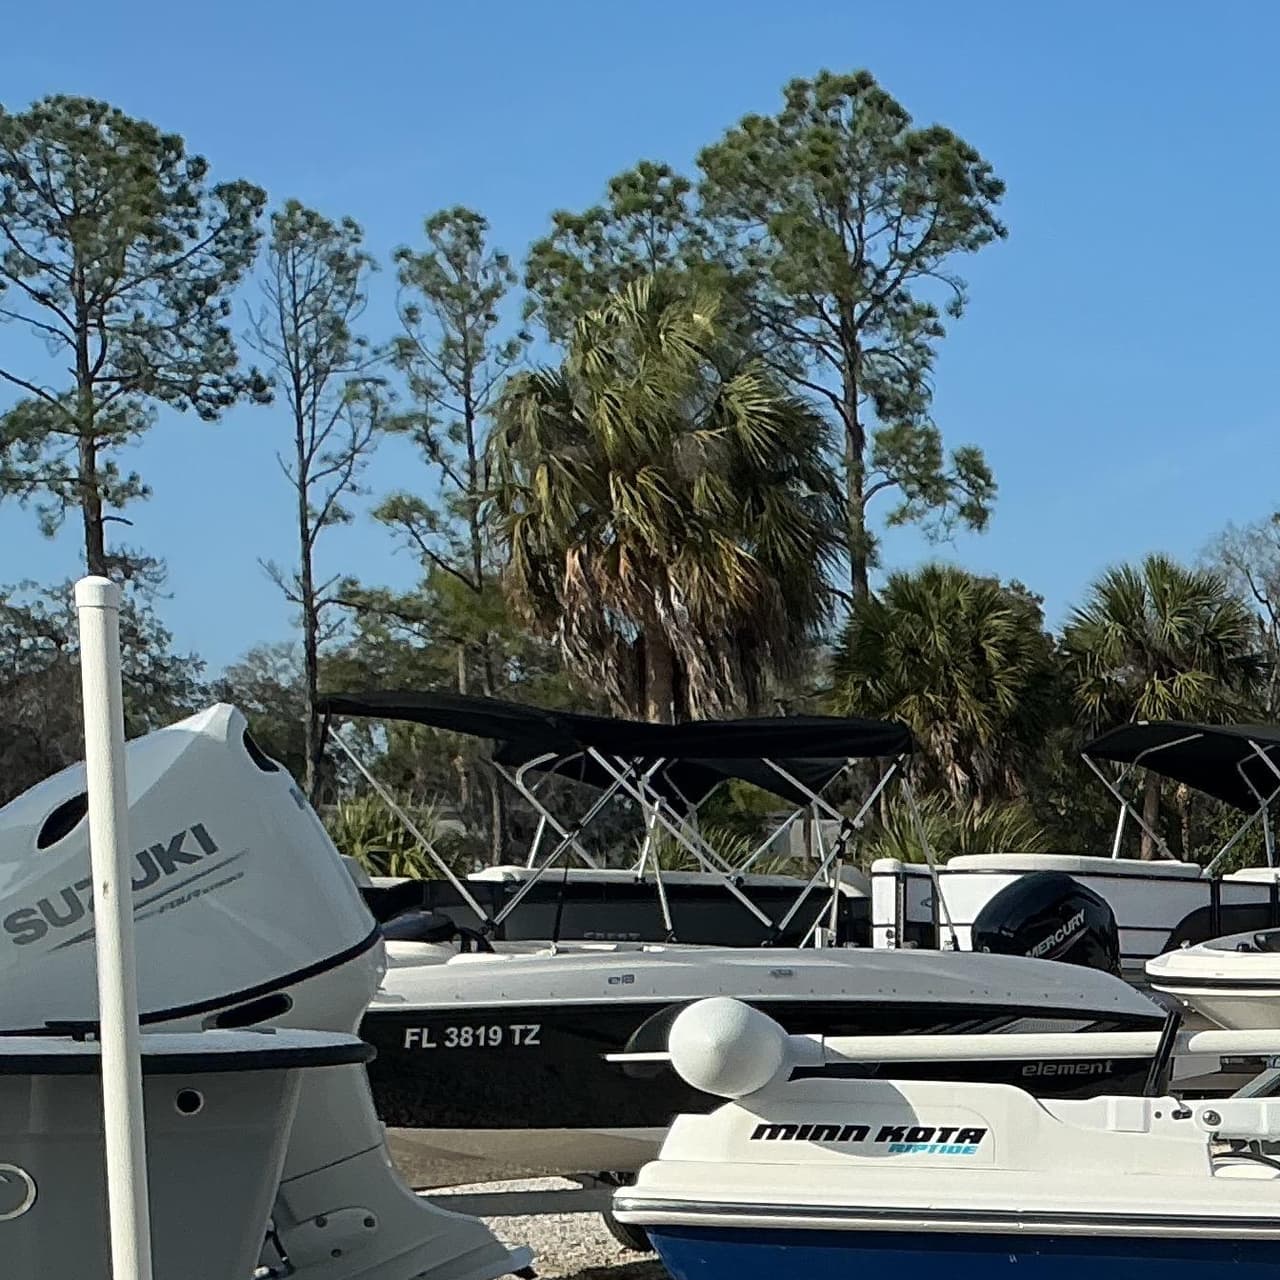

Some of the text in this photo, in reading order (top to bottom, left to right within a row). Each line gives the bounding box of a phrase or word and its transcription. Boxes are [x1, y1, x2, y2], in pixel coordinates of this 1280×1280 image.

[1025, 908, 1086, 958] MERCURY
[404, 1024, 541, 1049] FL 3819 TZ
[1022, 1060, 1113, 1077] element
[874, 1126, 988, 1144] KOTA
[888, 1144, 979, 1155] RIPTIDE
